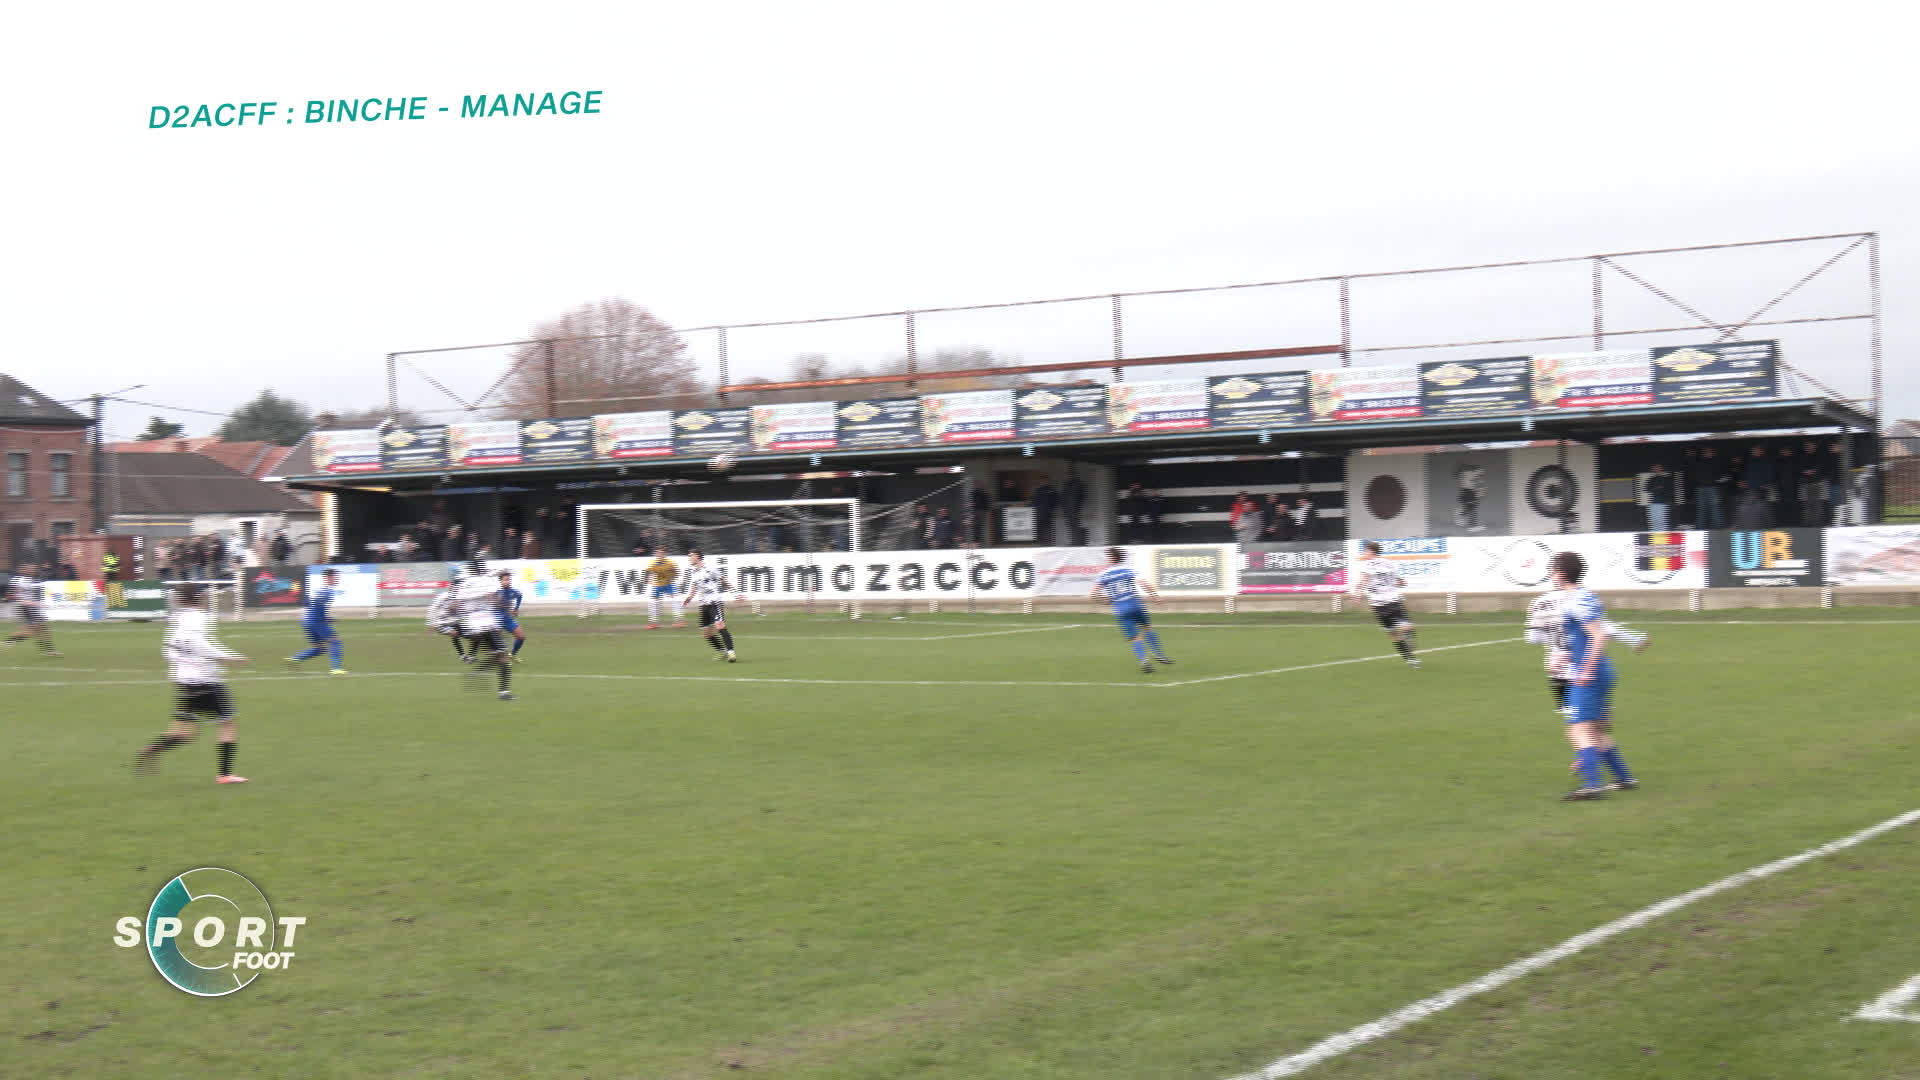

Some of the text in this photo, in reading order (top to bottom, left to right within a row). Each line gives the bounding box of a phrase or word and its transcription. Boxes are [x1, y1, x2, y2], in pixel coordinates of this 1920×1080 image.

[1377, 539, 1443, 554] ROUPE
[1160, 553, 1217, 569] immo
[1264, 551, 1347, 569] PRINTING
